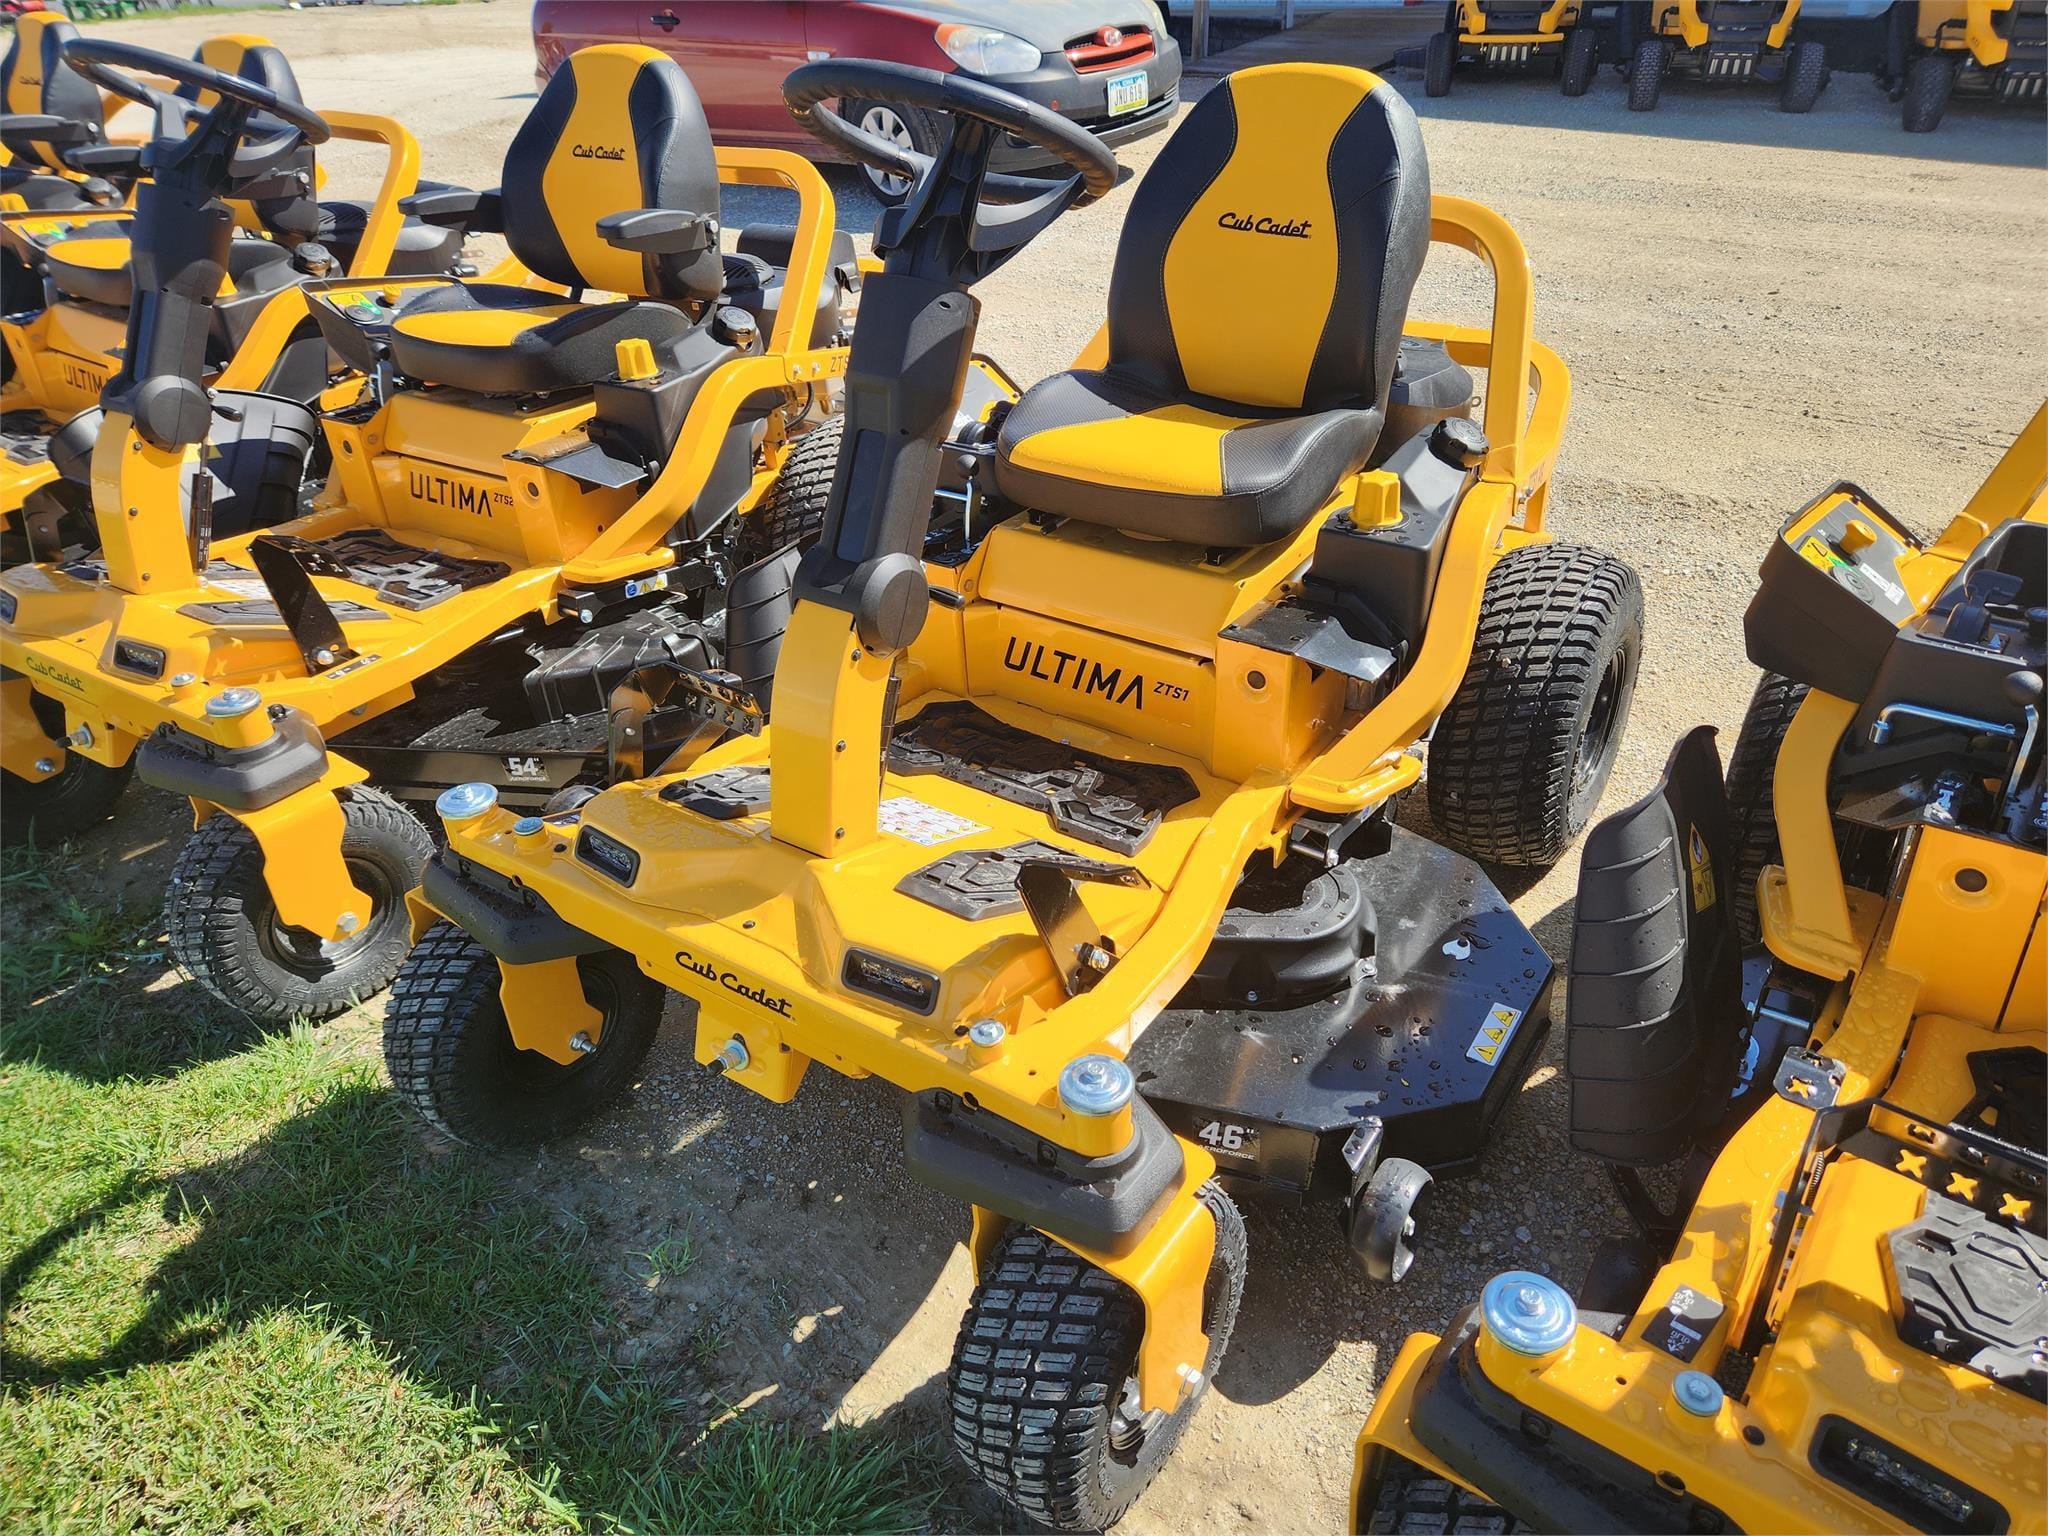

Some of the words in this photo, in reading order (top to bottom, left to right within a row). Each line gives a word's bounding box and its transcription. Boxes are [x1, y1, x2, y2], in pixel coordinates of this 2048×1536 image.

[572, 144, 593, 158] Cub
[594, 145, 626, 161] Cadet
[1218, 212, 1254, 231] Cub
[1254, 217, 1312, 239] Cadet
[63, 362, 108, 394] ULTIM
[410, 471, 493, 518] ULTIMA
[493, 491, 514, 507] ZTS2
[25, 656, 49, 676] Cub
[48, 665, 85, 692] Cadet
[1004, 636, 1144, 710] ULTIMA
[1153, 681, 1190, 702] ZTS1
[675, 951, 717, 981] Cub
[720, 972, 793, 1019] Cadet
